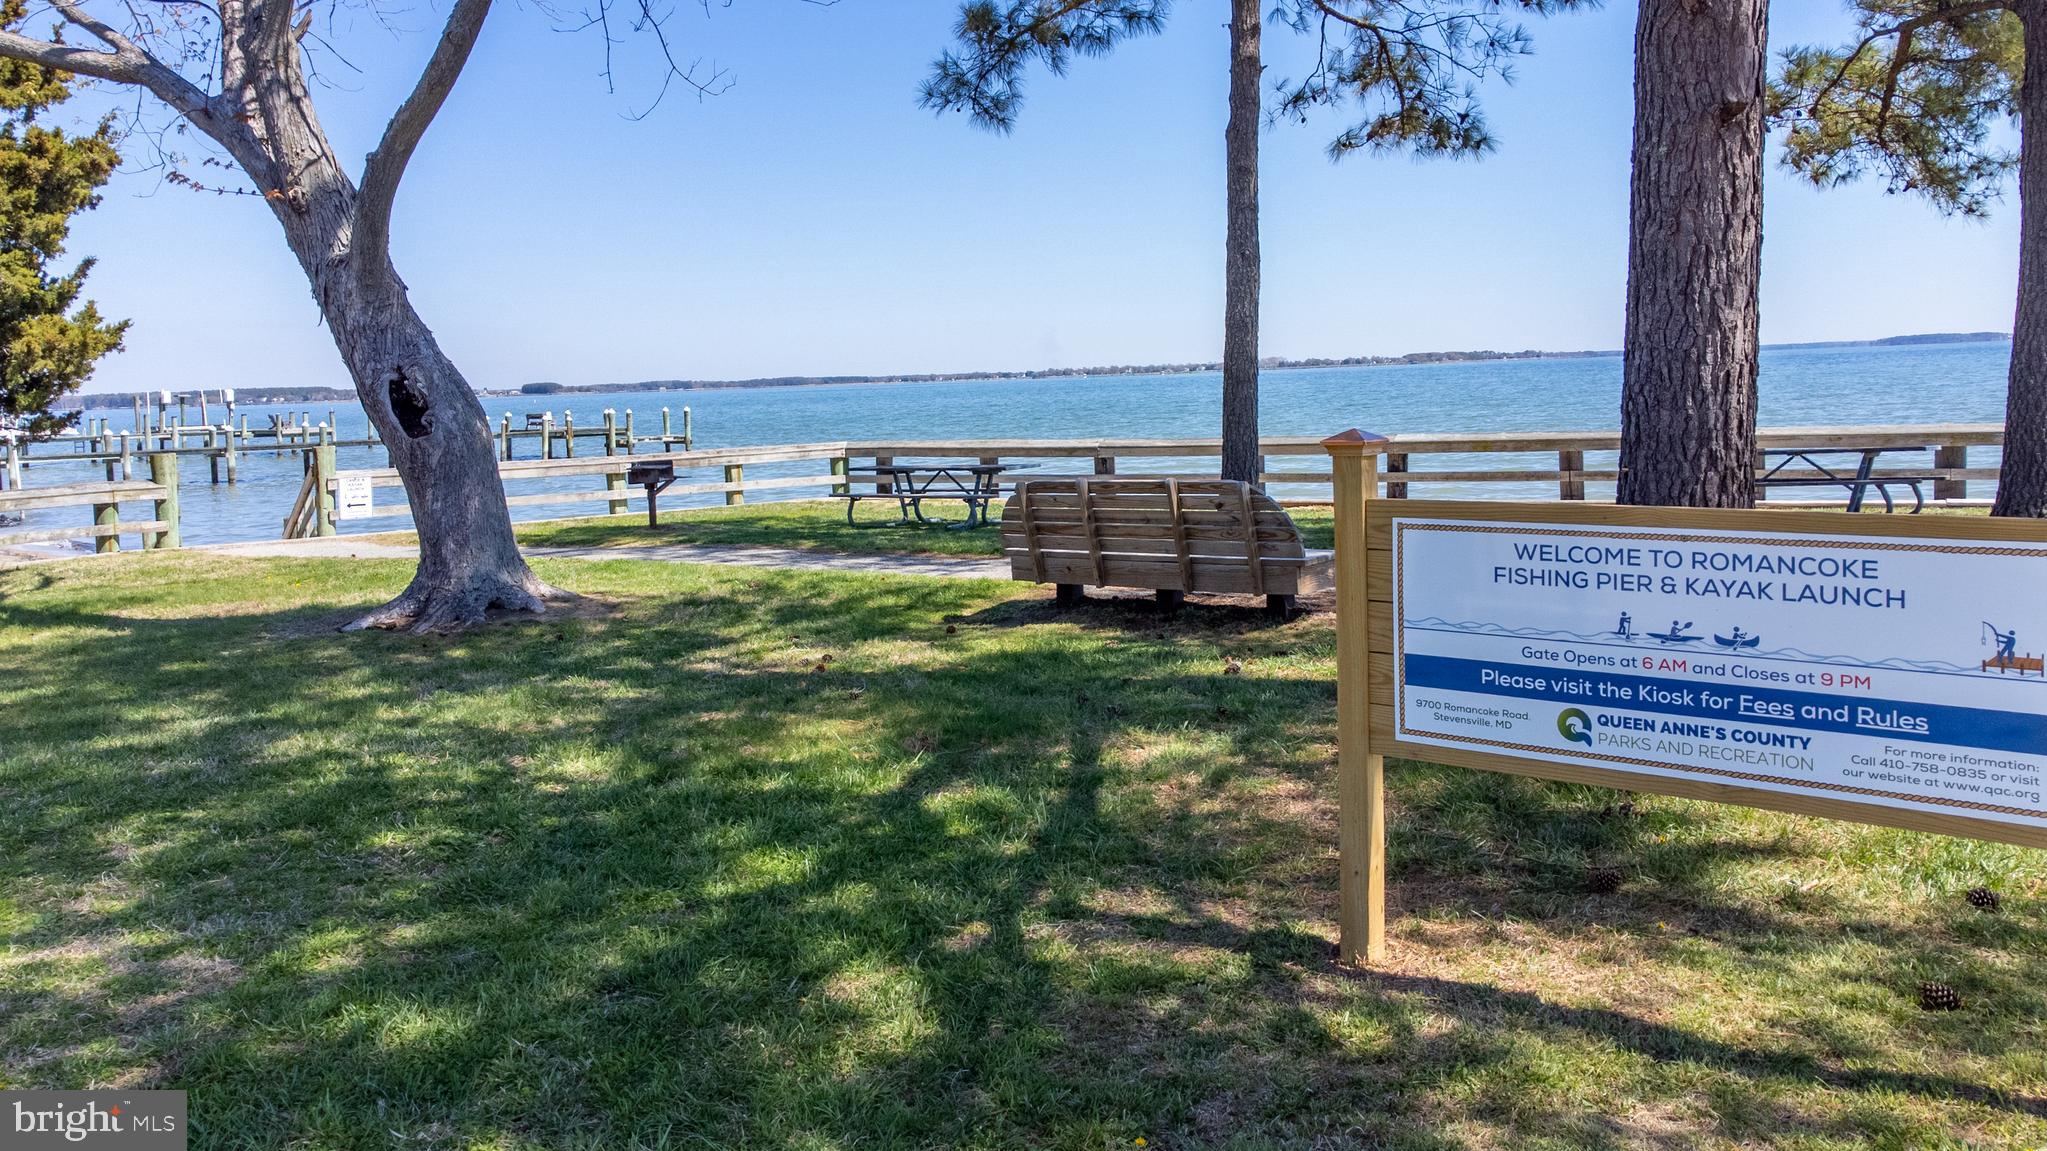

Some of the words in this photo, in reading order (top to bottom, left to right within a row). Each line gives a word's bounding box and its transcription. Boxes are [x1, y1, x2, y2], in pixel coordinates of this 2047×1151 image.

[1514, 543, 1641, 567] WELCOME
[1648, 549, 1683, 569] TO
[1692, 551, 1879, 579] ROMANCOKE
[1494, 566, 1588, 589] FISHING
[1597, 574, 1652, 593] PIER
[1660, 576, 1677, 594] &
[1686, 577, 1774, 601] KAYAK
[1782, 584, 1906, 609] LAUNCH
[1522, 646, 1559, 661] Gate
[1563, 650, 1615, 668] Opens
[1620, 654, 1638, 668] at
[1642, 657, 1654, 670] 6
[1658, 657, 1687, 673] AM
[1692, 661, 1726, 677] and
[1731, 665, 1790, 683] Closes
[1796, 670, 1815, 685] at
[1820, 672, 1833, 687] 9
[1840, 674, 1871, 690] PM
[1415, 698, 1442, 710] 9700
[1444, 701, 1500, 717] Romancoke
[1481, 669, 1546, 691] Please
[1551, 677, 1592, 696] visit
[1597, 681, 1632, 700] the
[1639, 685, 1694, 707] Kiosk
[1700, 690, 1734, 710] for
[1738, 695, 1795, 720] Fees
[1801, 703, 1849, 723] and
[1856, 707, 1930, 734] Rules
[1433, 712, 1493, 728] Stevensville,
[1495, 719, 1512, 730] MD
[1597, 713, 1656, 733] QUEEN
[1659, 719, 1727, 741] ANNE'S
[1731, 729, 1812, 750] COUNTY
[1598, 733, 1652, 751] PARKS
[1656, 740, 1694, 756] AND
[1698, 745, 1814, 772] RECREATION
[1851, 754, 1876, 767] Call
[1879, 758, 1987, 780] 410-758-0835
[1991, 772, 2006, 782] or
[2009, 772, 2040, 786] visit
[1884, 745, 1914, 758] For
[1918, 750, 1947, 763] more
[1950, 752, 2040, 773] information:
[1842, 768, 1864, 779] our
[1868, 769, 1921, 786] website
[1924, 777, 1940, 788] at
[1943, 778, 2040, 803] www.qac.org
